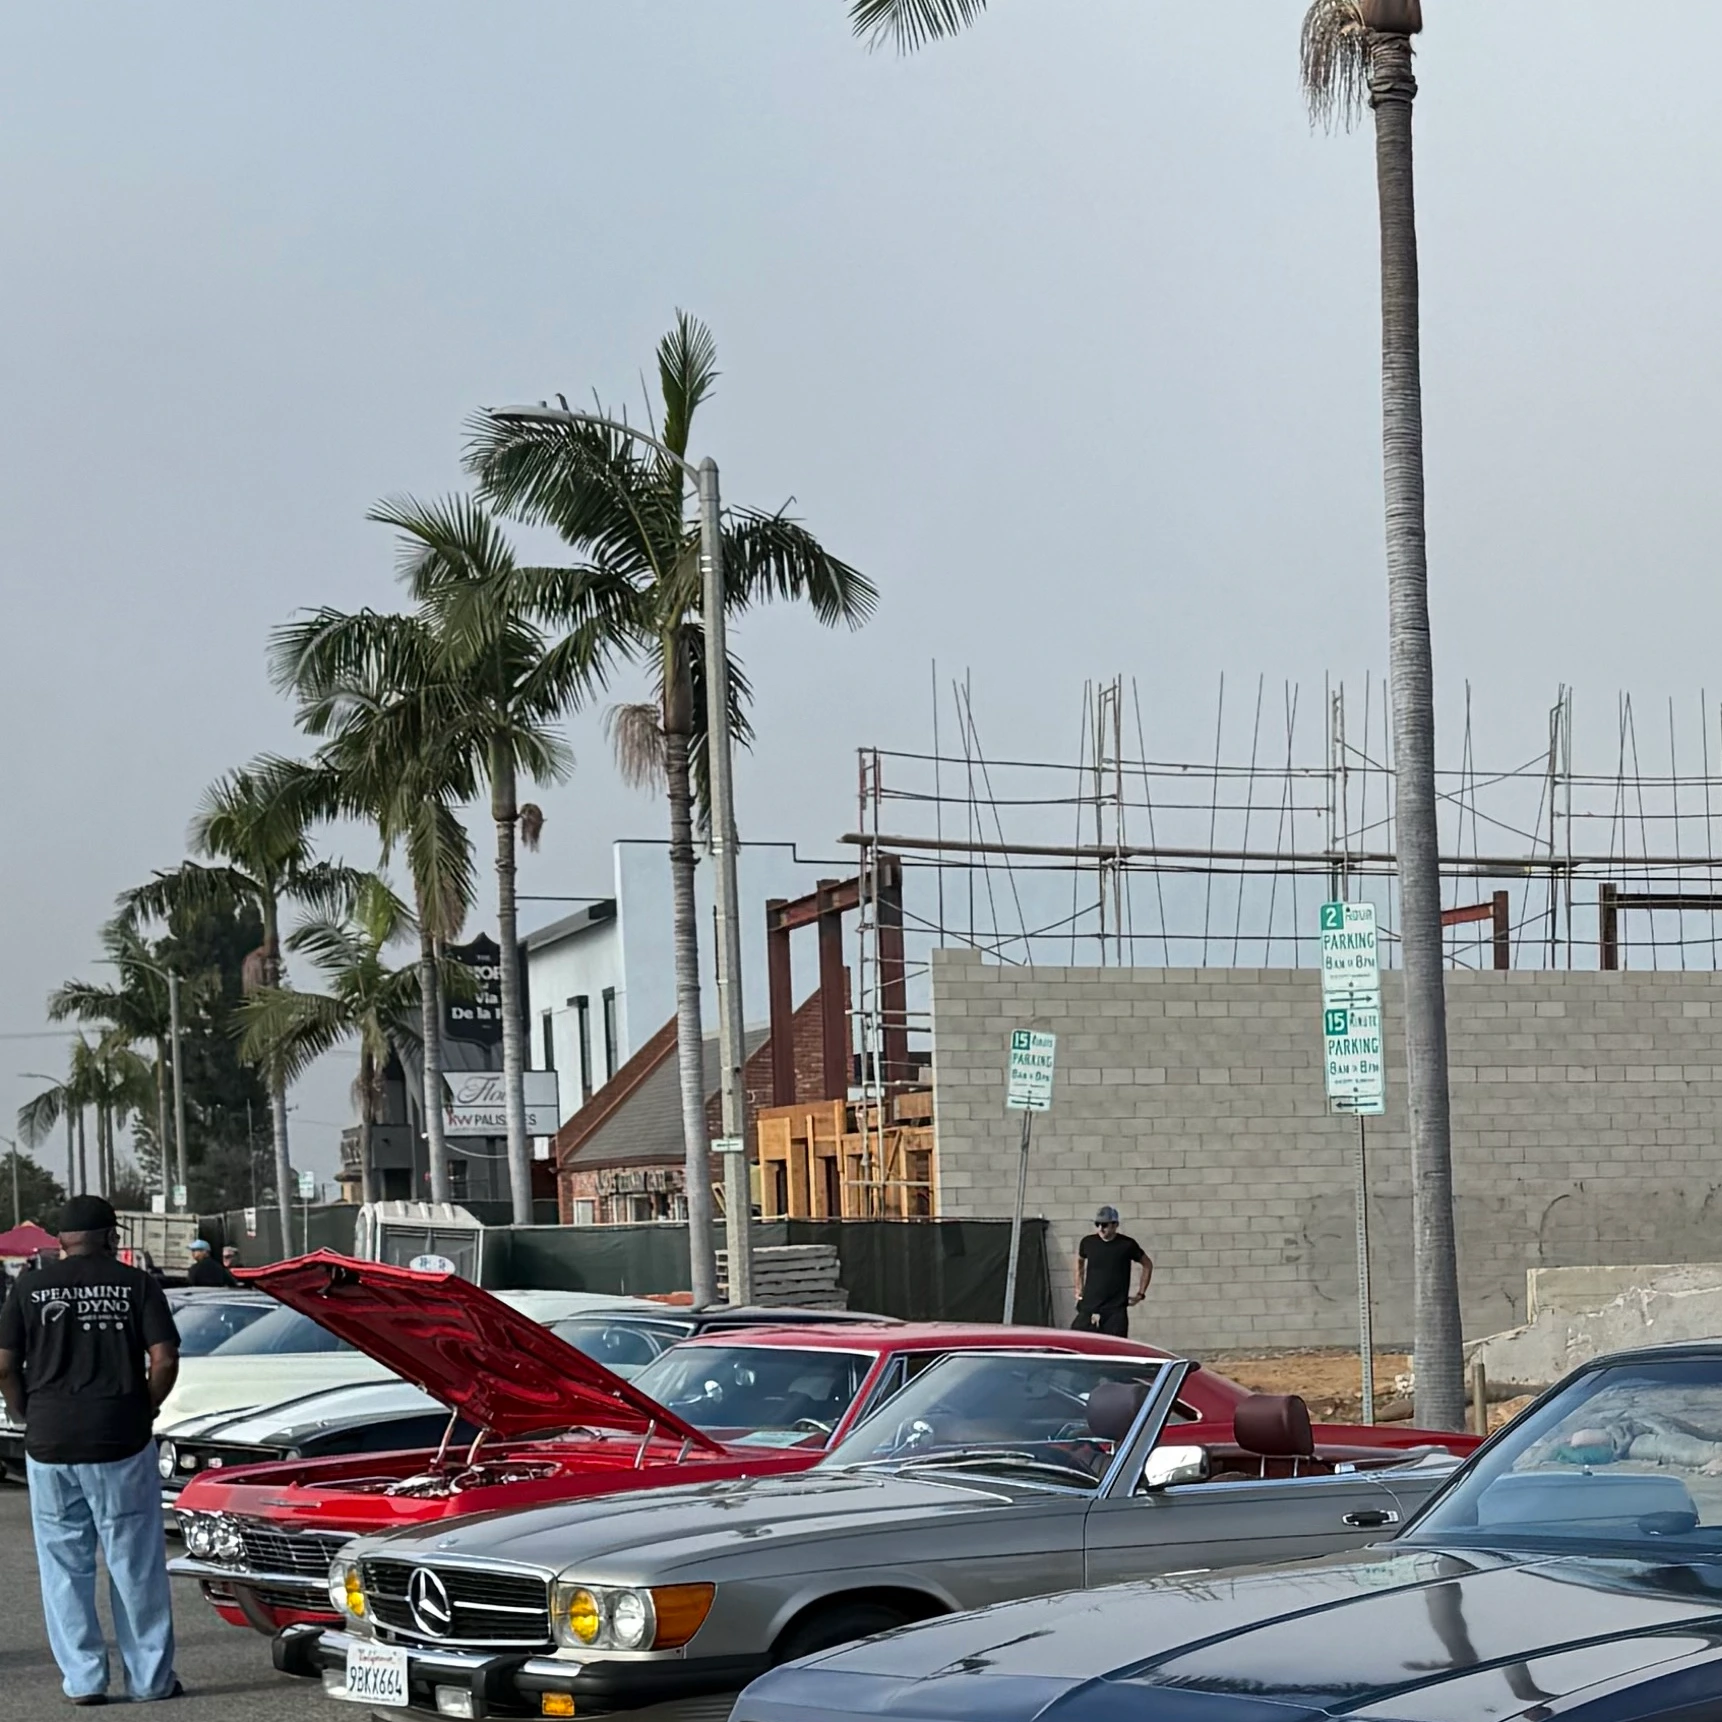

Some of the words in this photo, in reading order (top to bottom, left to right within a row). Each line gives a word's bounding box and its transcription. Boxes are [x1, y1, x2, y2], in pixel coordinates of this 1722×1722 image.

[1326, 907, 1337, 927] 2
[1324, 932, 1374, 950] PARKING
[452, 1007, 474, 1019] De
[1327, 1012, 1345, 1032] 15
[1014, 1032, 1029, 1048] 15
[1328, 1038, 1379, 1056] PARKING
[1012, 1053, 1052, 1068] PARKING
[475, 1114, 537, 1126] PALISS
[31, 1286, 131, 1303] SPEARMINT
[77, 1300, 130, 1313] DYNO
[349, 1666, 402, 1697] 9BKX664
